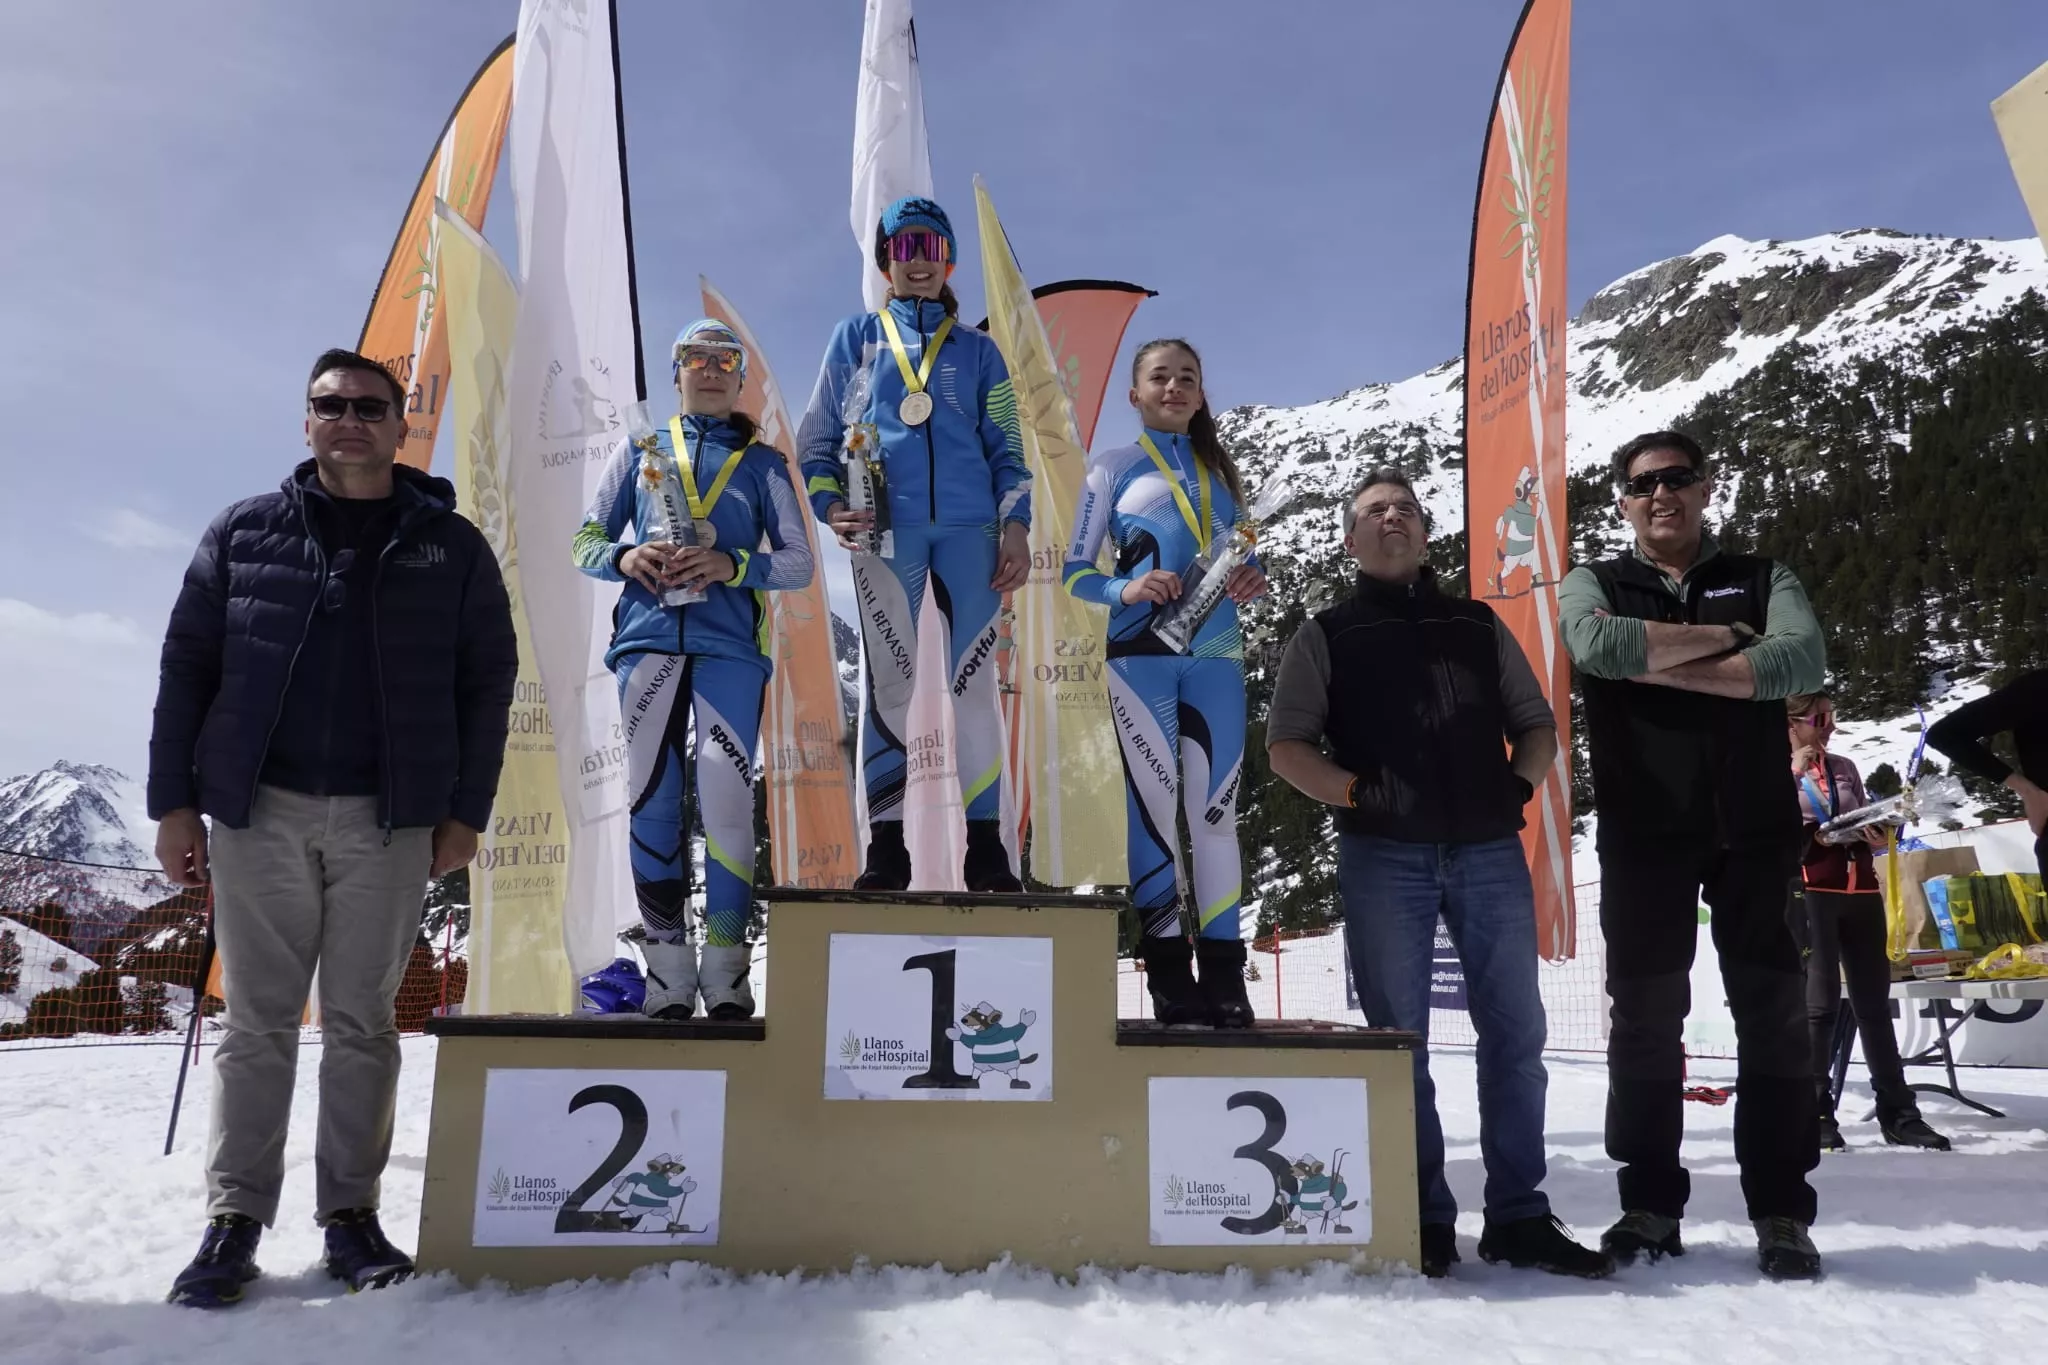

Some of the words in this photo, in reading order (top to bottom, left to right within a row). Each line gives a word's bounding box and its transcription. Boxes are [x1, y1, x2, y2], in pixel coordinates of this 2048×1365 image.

[1079, 491, 1096, 541] sportful
[856, 567, 877, 610] A.D.H.
[636, 655, 679, 713] BENASQUE
[954, 626, 998, 697] sportful
[710, 724, 752, 787] sportfu
[1112, 695, 1135, 734] A.D.H.
[1131, 733, 1176, 798] BENASQUE
[1220, 761, 1243, 807] sport
[864, 1036, 904, 1050] Llanos
[902, 949, 980, 1089] 1
[862, 1052, 877, 1062] del
[878, 1049, 929, 1065] Hospital
[514, 1175, 557, 1189] Llanos
[554, 1084, 648, 1234] 2
[1220, 1090, 1299, 1235] 3
[511, 1191, 526, 1202] del
[528, 1188, 572, 1205] Hospit
[1185, 1196, 1200, 1206] del
[1200, 1193, 1250, 1208] Hospital
[1186, 1180, 1226, 1194] Llanos
